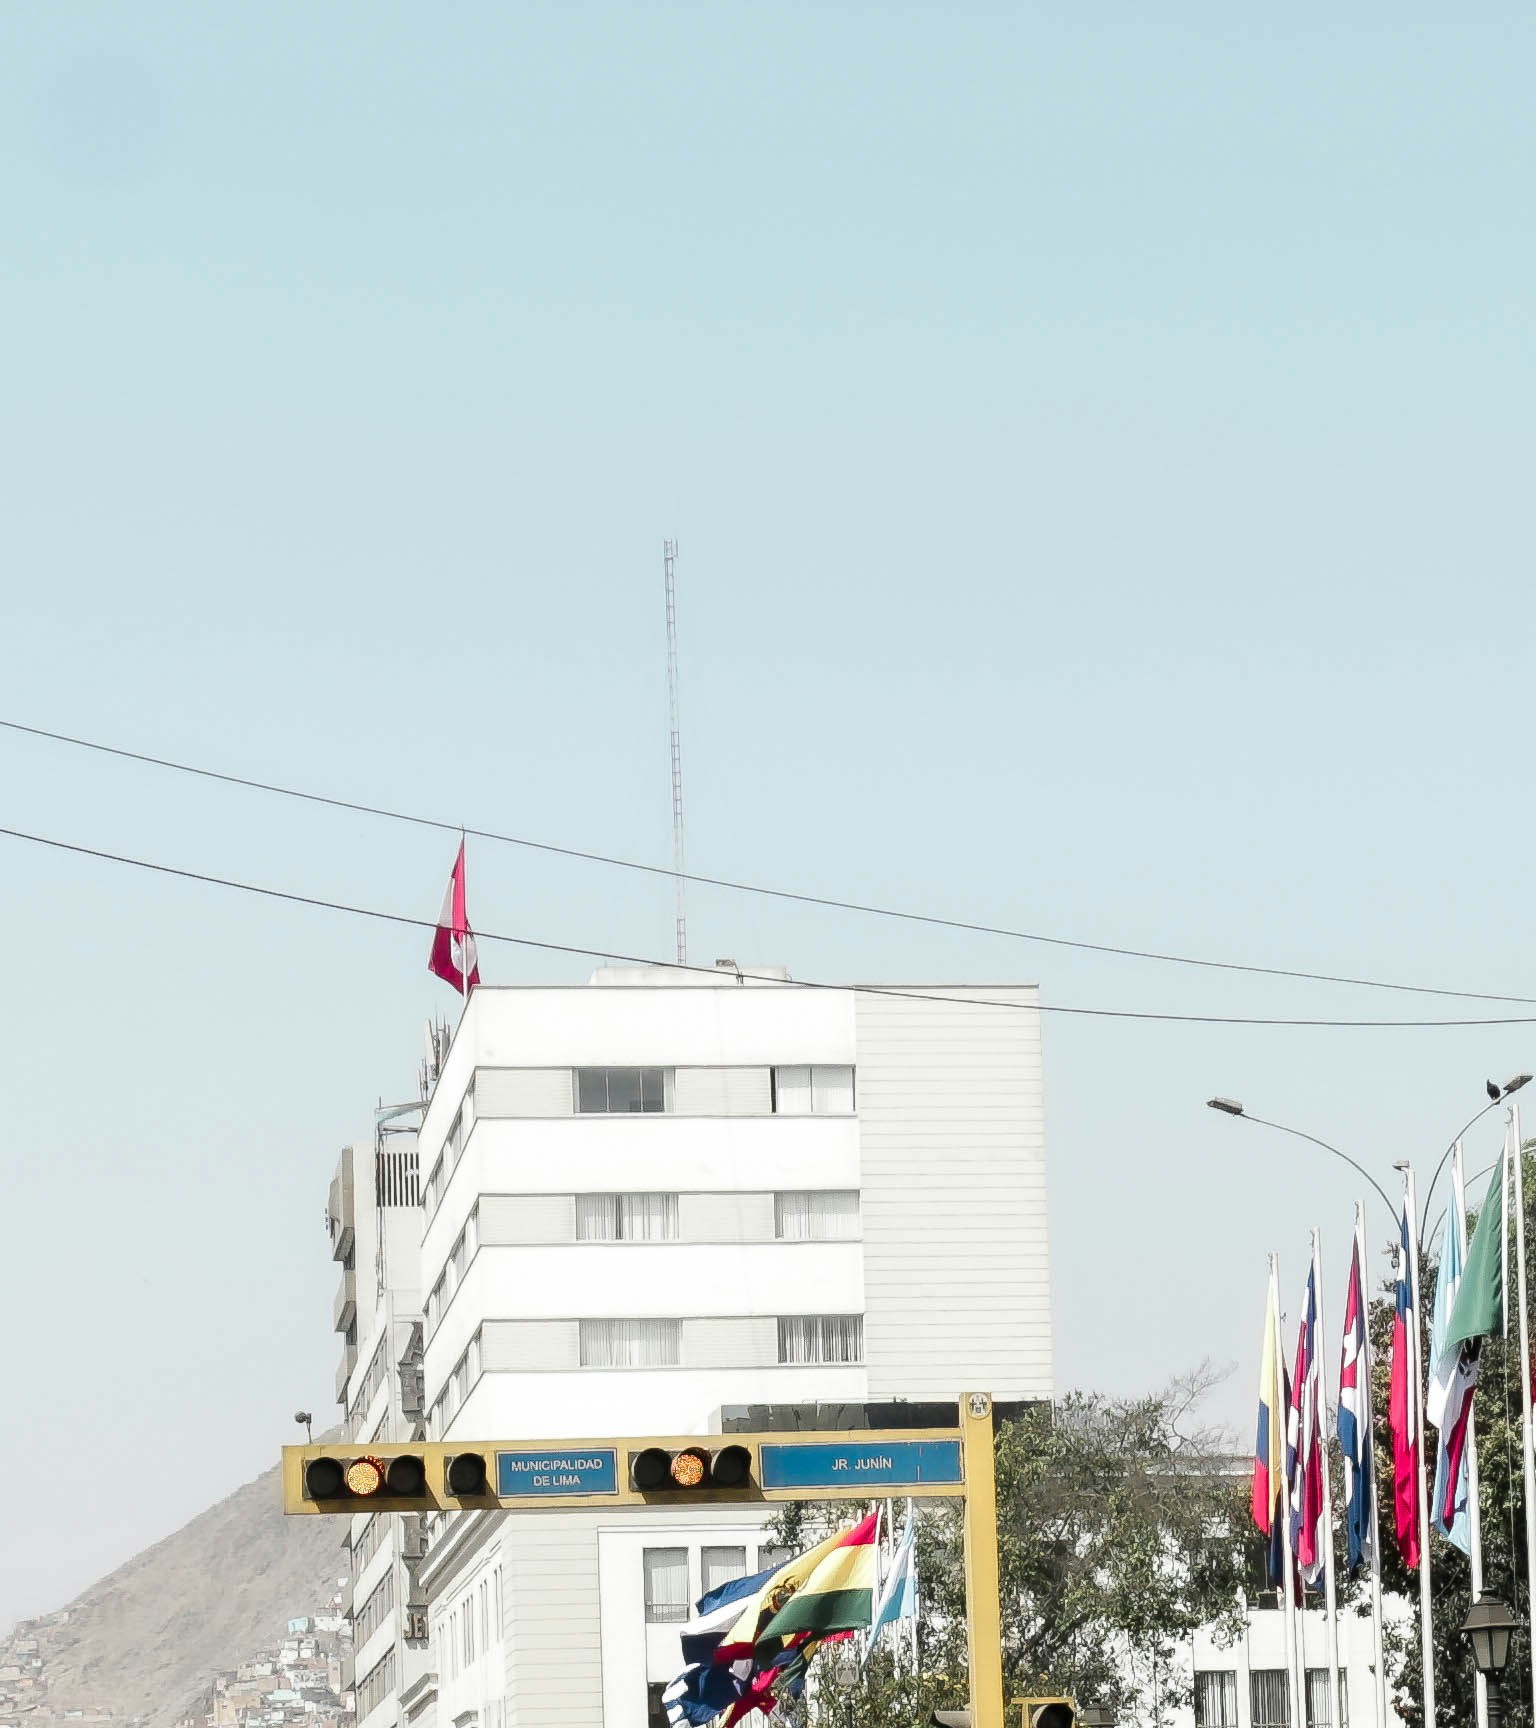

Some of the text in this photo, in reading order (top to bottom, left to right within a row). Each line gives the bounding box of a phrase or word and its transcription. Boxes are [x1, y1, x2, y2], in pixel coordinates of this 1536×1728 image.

[511, 1457, 603, 1473] MUNICIPALIDAD
[831, 1455, 892, 1472] JR. JUNÍN
[532, 1474, 581, 1487] DE LIMA
